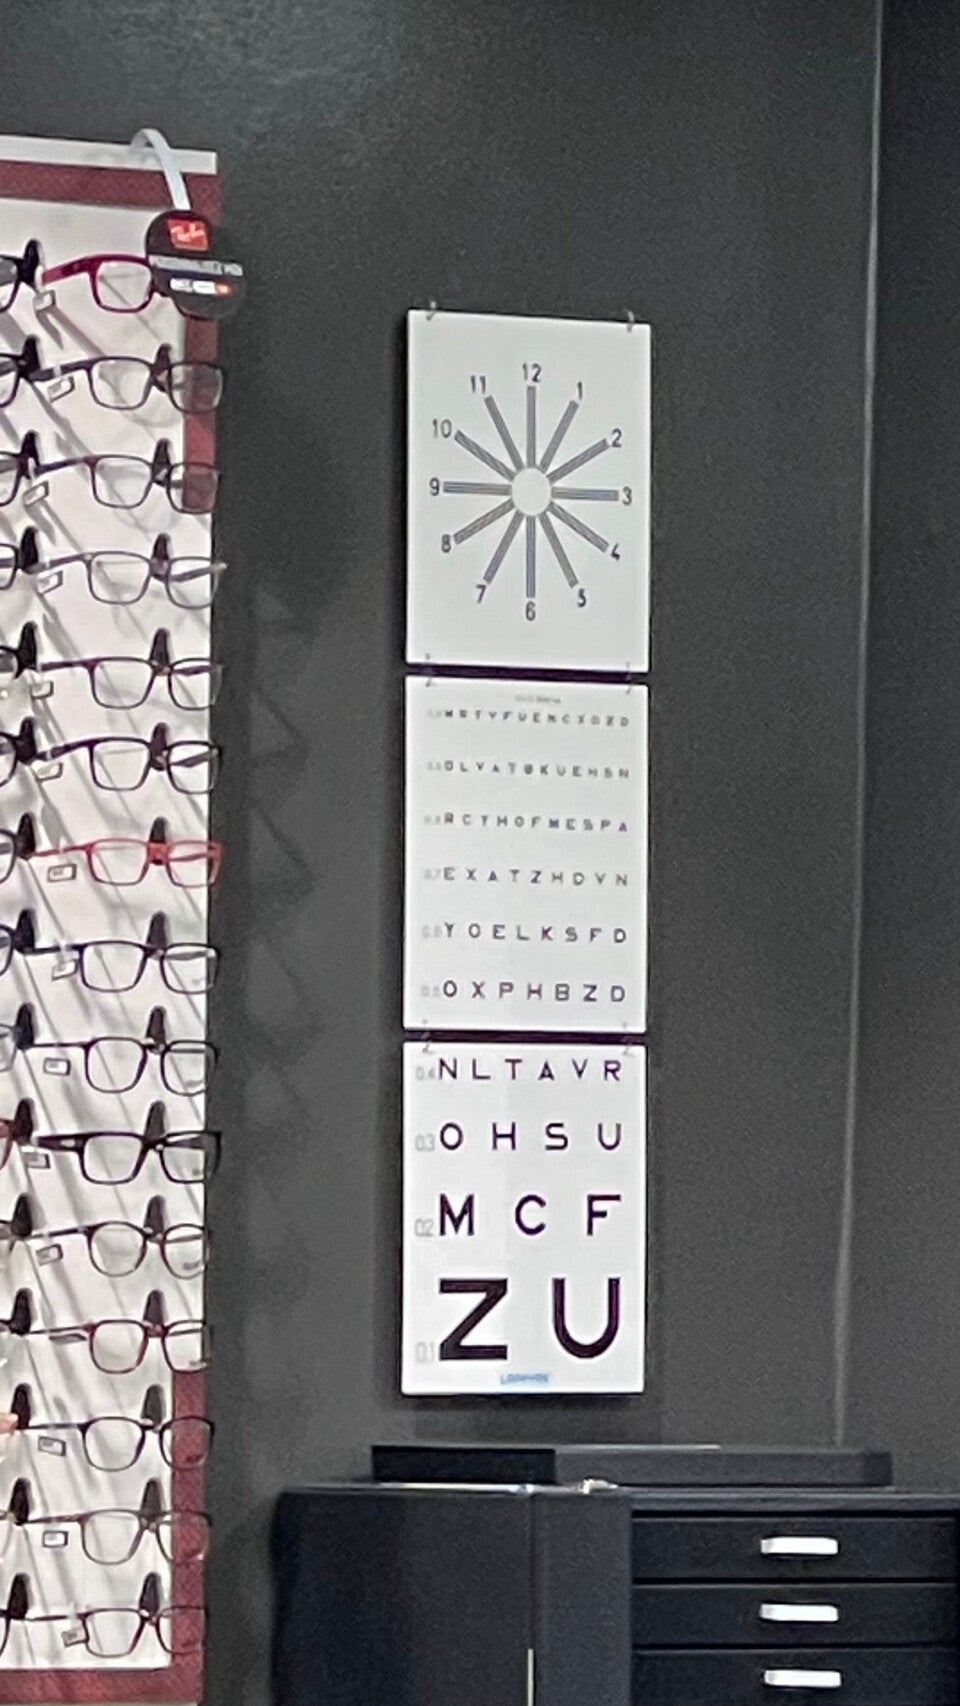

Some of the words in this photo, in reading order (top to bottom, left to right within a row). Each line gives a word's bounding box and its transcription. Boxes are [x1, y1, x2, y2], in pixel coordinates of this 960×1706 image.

[522, 363, 542, 383] 12
[470, 375, 486, 394] 11
[432, 418, 452, 439] 10
[611, 427, 623, 449] 2
[429, 477, 440, 497] 9
[622, 486, 633, 506] 3
[441, 534, 452, 554] 8
[610, 542, 621, 561] 4
[476, 584, 487, 604] 7
[577, 588, 587, 608] 5
[525, 600, 536, 622] 6
[439, 1193, 475, 1237] M
[514, 1194, 547, 1236] C
[586, 1194, 622, 1237] F
[438, 1277, 509, 1362] Z
[552, 1277, 621, 1359] U
